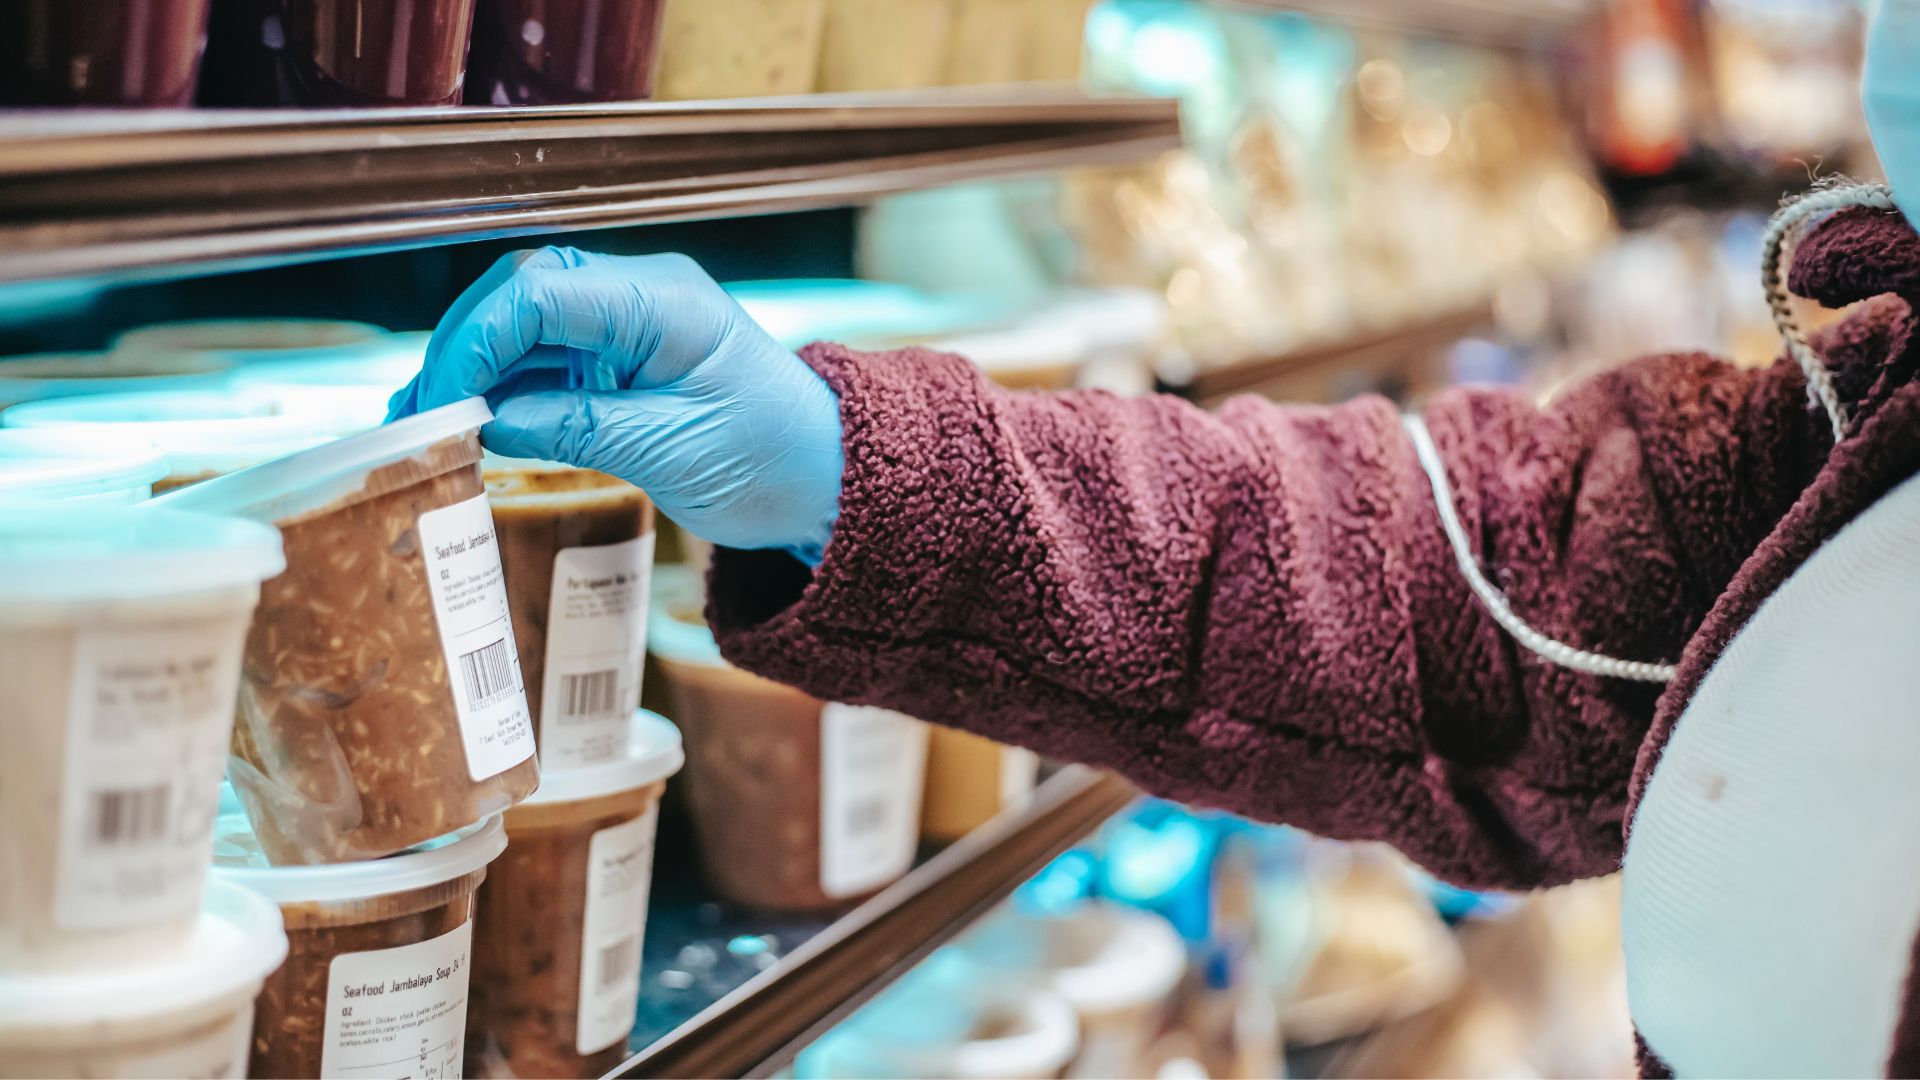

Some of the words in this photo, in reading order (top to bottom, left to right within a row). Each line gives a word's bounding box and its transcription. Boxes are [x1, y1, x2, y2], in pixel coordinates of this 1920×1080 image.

[436, 538, 466, 560] Seafood
[343, 981, 385, 998] Seafood
[390, 974, 433, 993] Jambalaya
[436, 967, 451, 981] Soup
[342, 1006, 352, 1017] OZ
